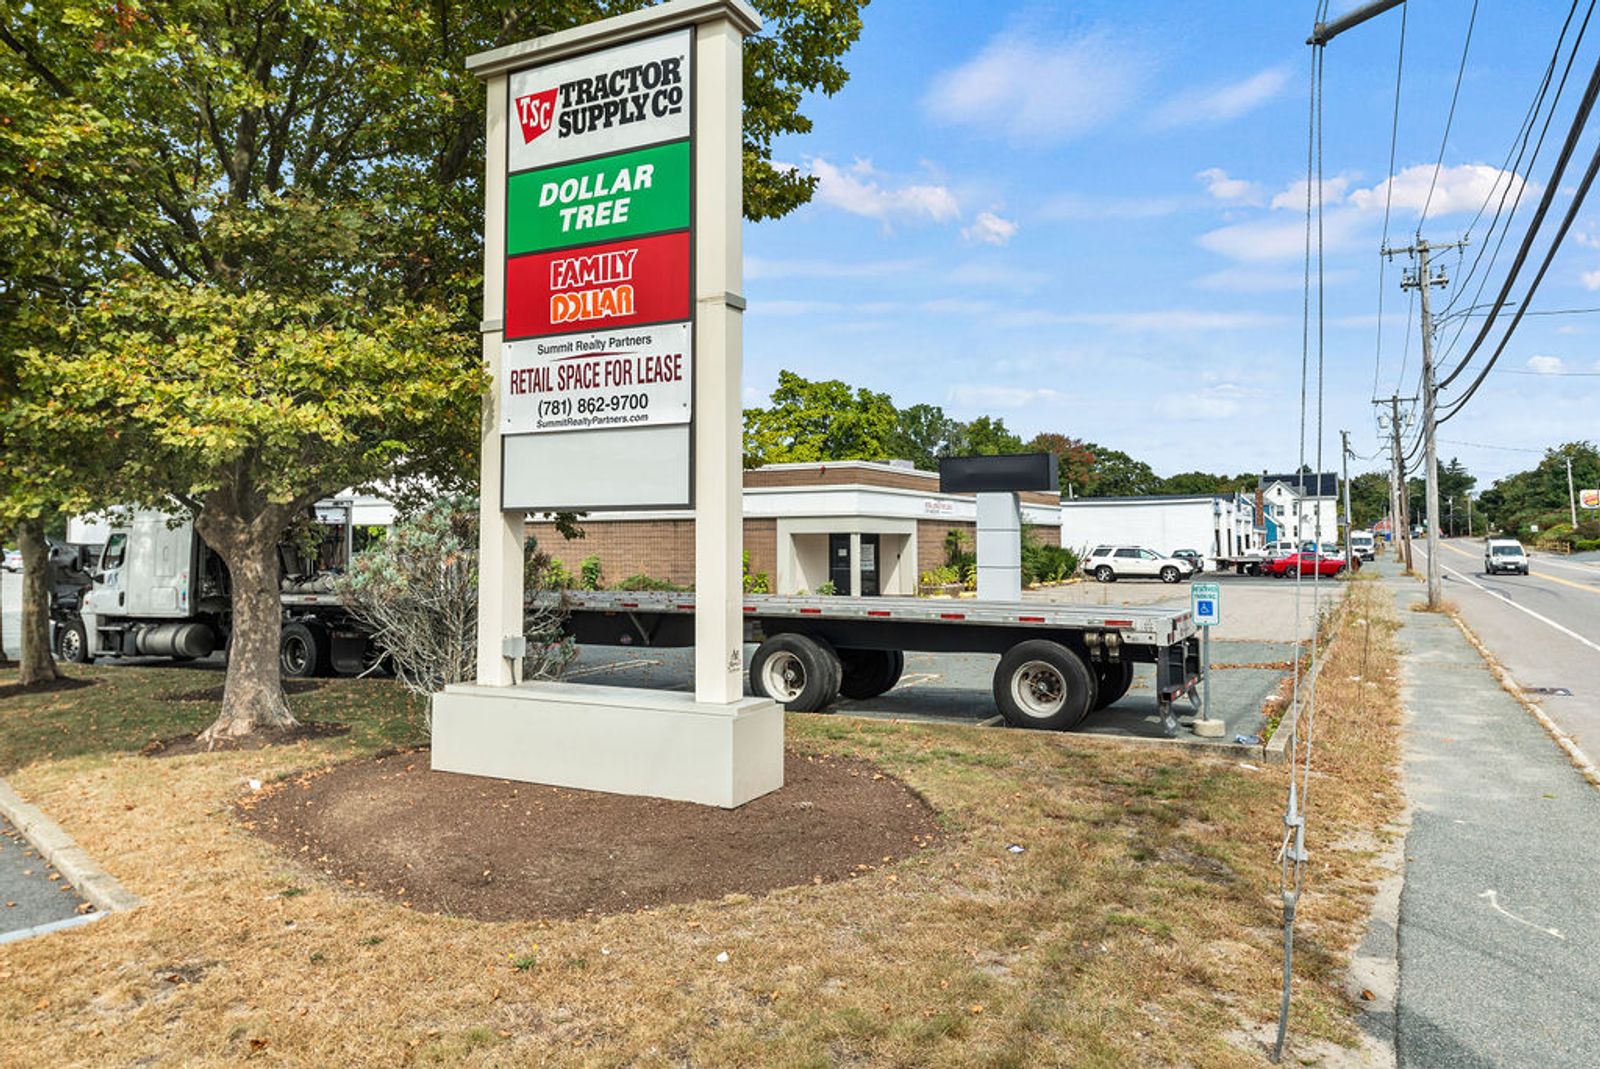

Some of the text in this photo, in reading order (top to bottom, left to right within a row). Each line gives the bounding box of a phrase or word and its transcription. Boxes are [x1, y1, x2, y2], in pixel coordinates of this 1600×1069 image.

[559, 57, 681, 108] TRACTOR
[520, 97, 550, 130] TSC
[558, 93, 649, 138] SUPPLY
[538, 164, 654, 207] DOLLAR
[559, 198, 631, 232] TREE
[550, 249, 638, 290] FAMILY
[550, 284, 635, 324] DOLLAR
[537, 334, 652, 355] Summit Realty Partners
[510, 354, 682, 395] RETAIL SPACE FOR LEASE
[536, 413, 649, 429] SummitRealtyPartners.com
[537, 393, 649, 418] (781) 862-9700
